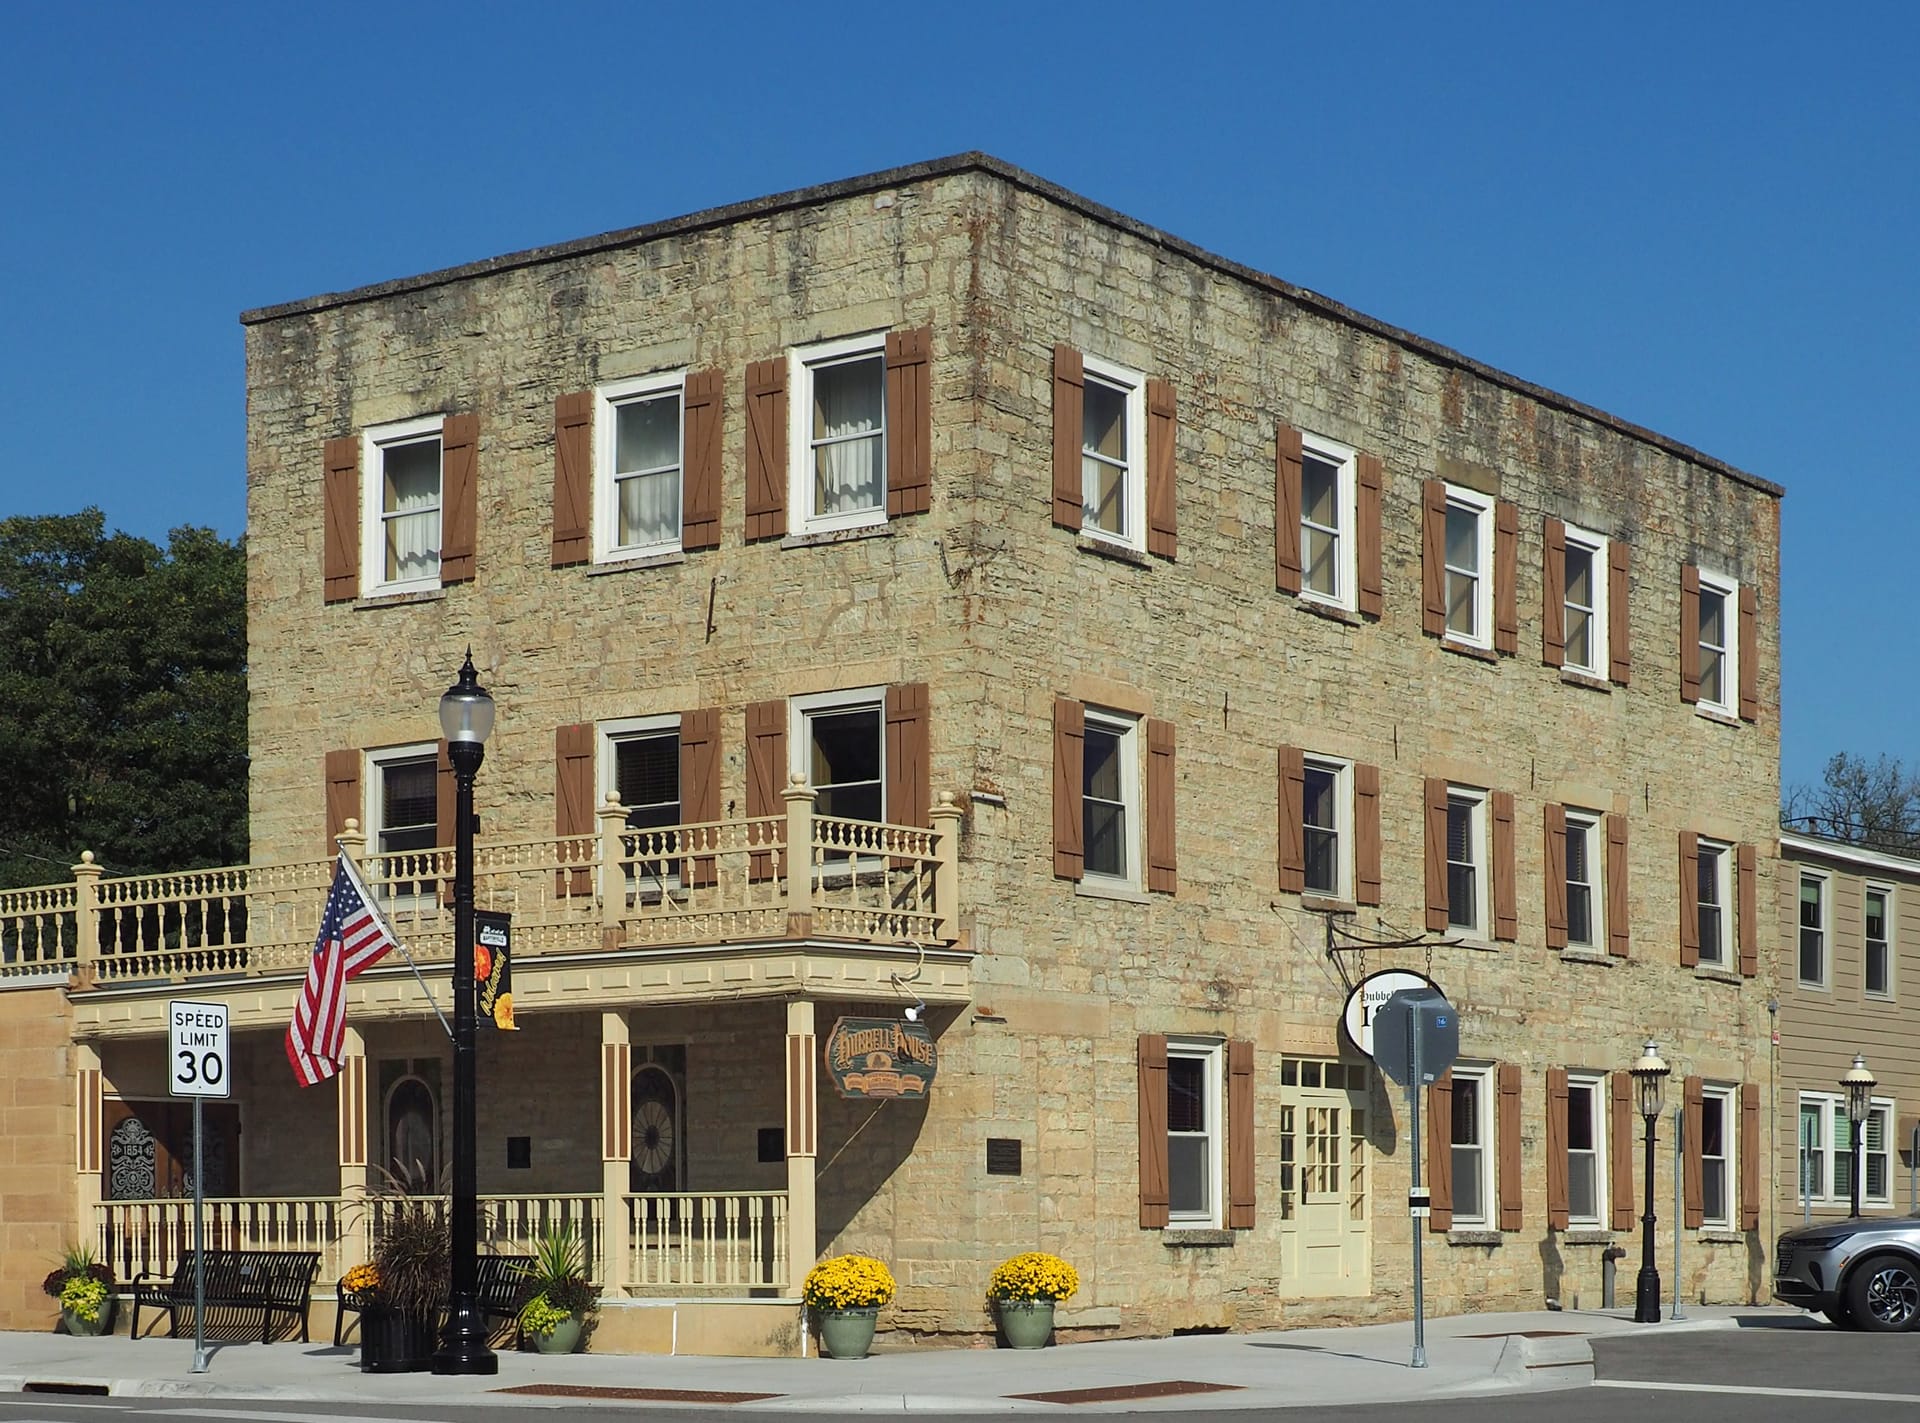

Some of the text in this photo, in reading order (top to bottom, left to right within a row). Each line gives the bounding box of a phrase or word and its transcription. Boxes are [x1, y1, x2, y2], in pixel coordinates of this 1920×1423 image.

[175, 1012, 223, 1029] SPEED
[180, 1032, 218, 1047] LIMIT
[177, 1050, 223, 1085] 30
